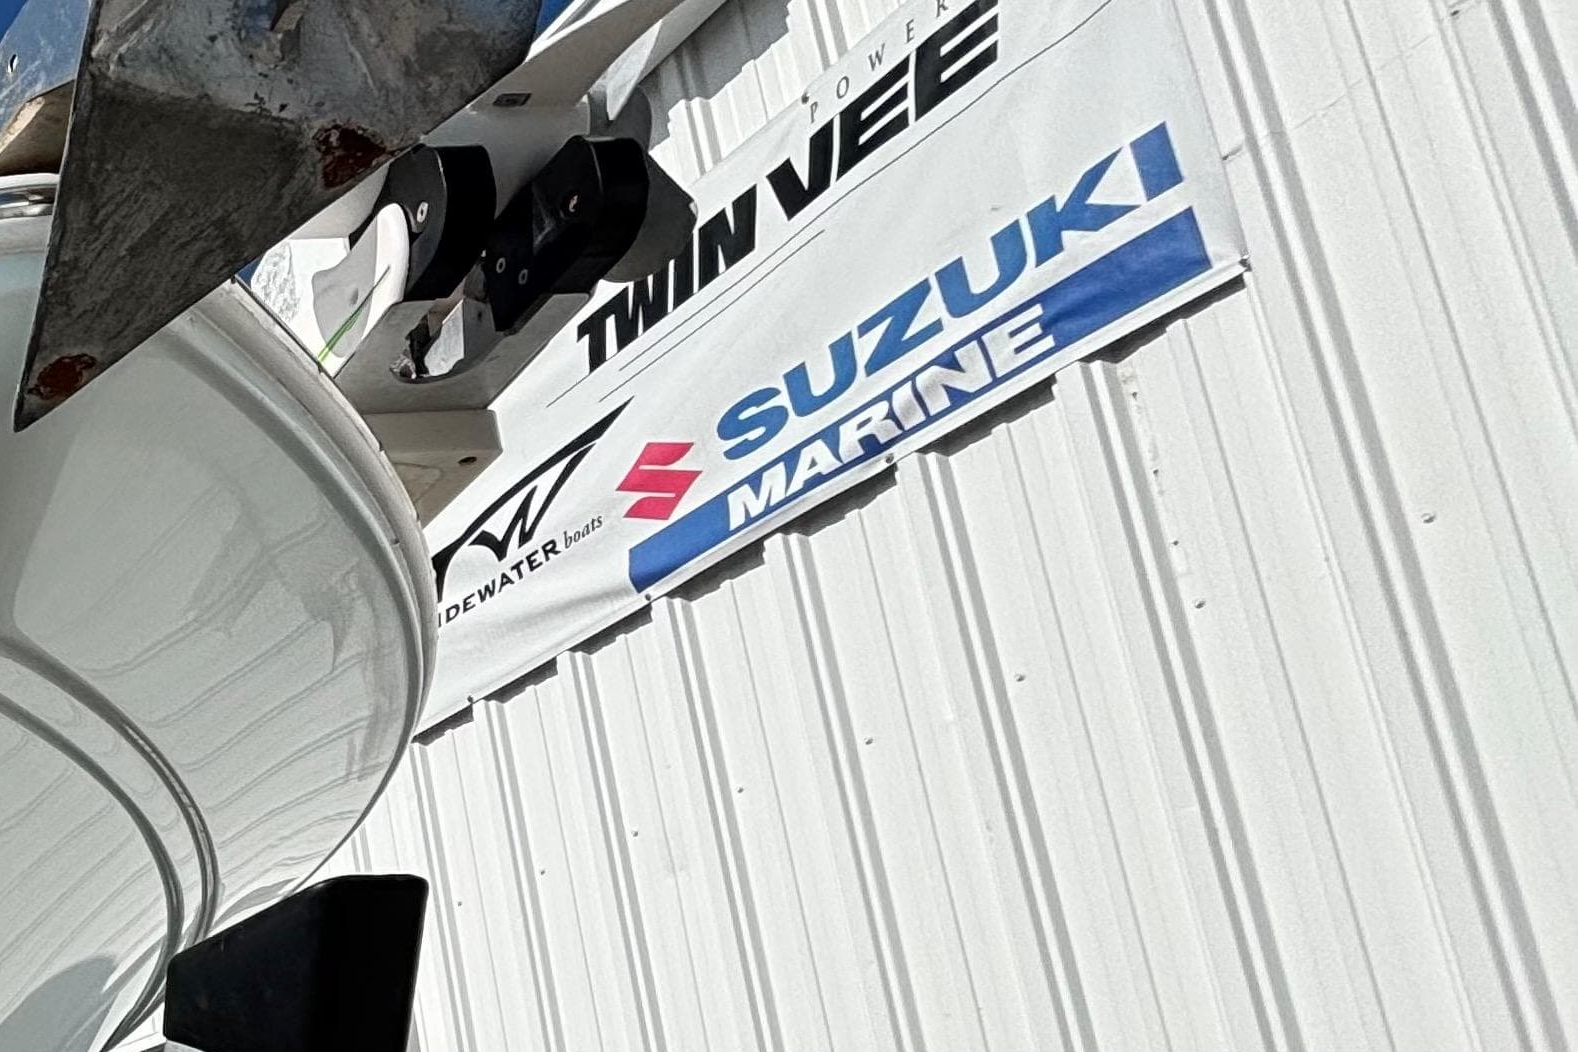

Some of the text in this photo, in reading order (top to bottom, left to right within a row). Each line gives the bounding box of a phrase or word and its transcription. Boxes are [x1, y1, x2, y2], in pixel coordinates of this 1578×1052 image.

[577, 0, 999, 374] TWIN VEE
[717, 121, 1184, 460] SUZUKI
[727, 303, 1055, 531] MARINE
[437, 515, 603, 628] IDEWATER boats
